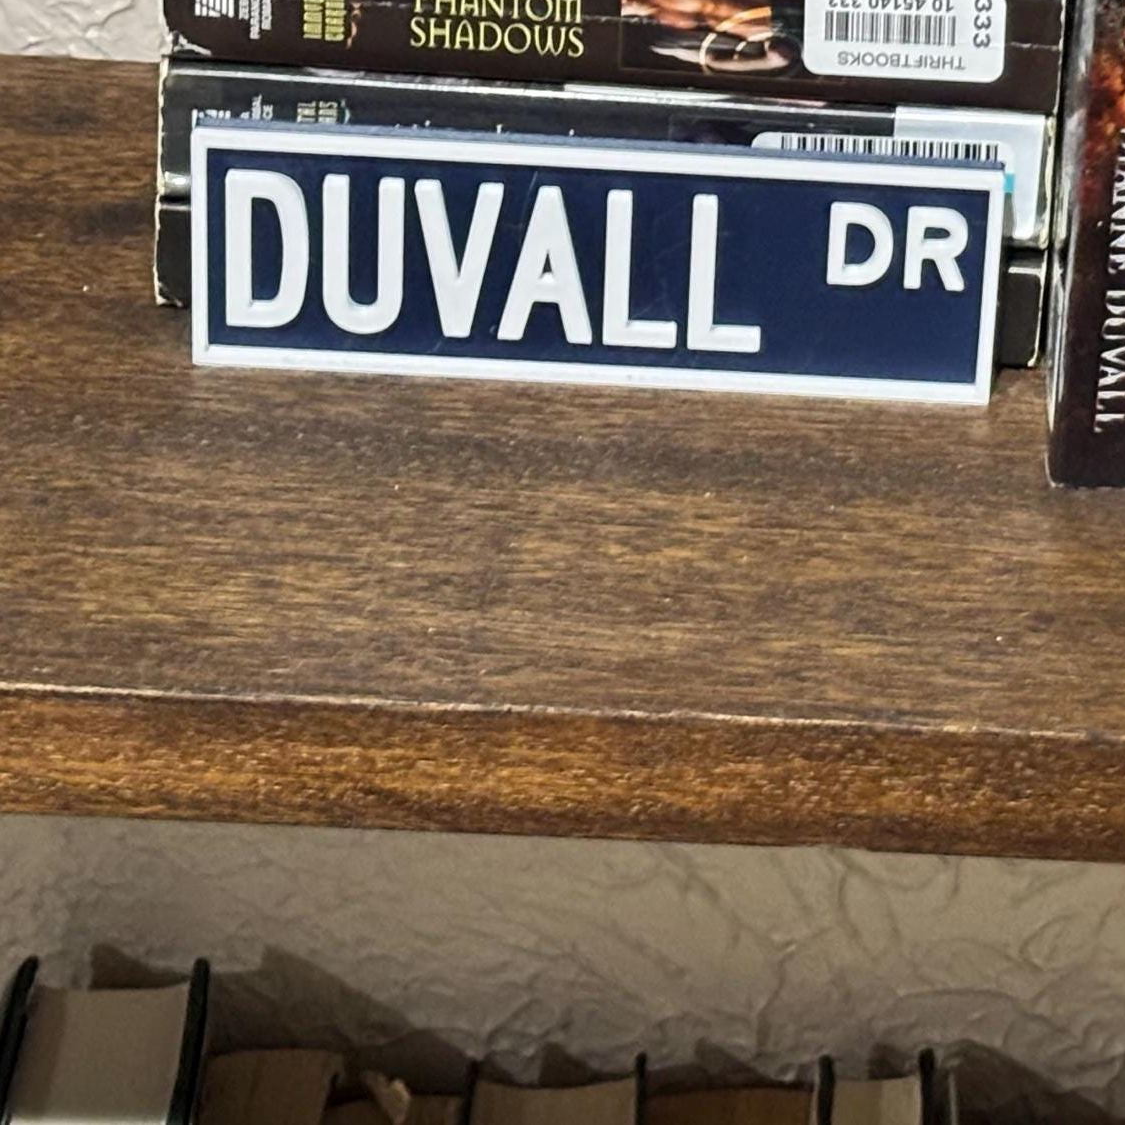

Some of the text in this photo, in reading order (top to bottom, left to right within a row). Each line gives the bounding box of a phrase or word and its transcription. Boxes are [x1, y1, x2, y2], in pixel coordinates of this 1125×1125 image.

[410, 16, 585, 58] SHADOWS
[837, 51, 967, 71] THRIFTBOOKS
[224, 168, 971, 353] DUVALL DR
